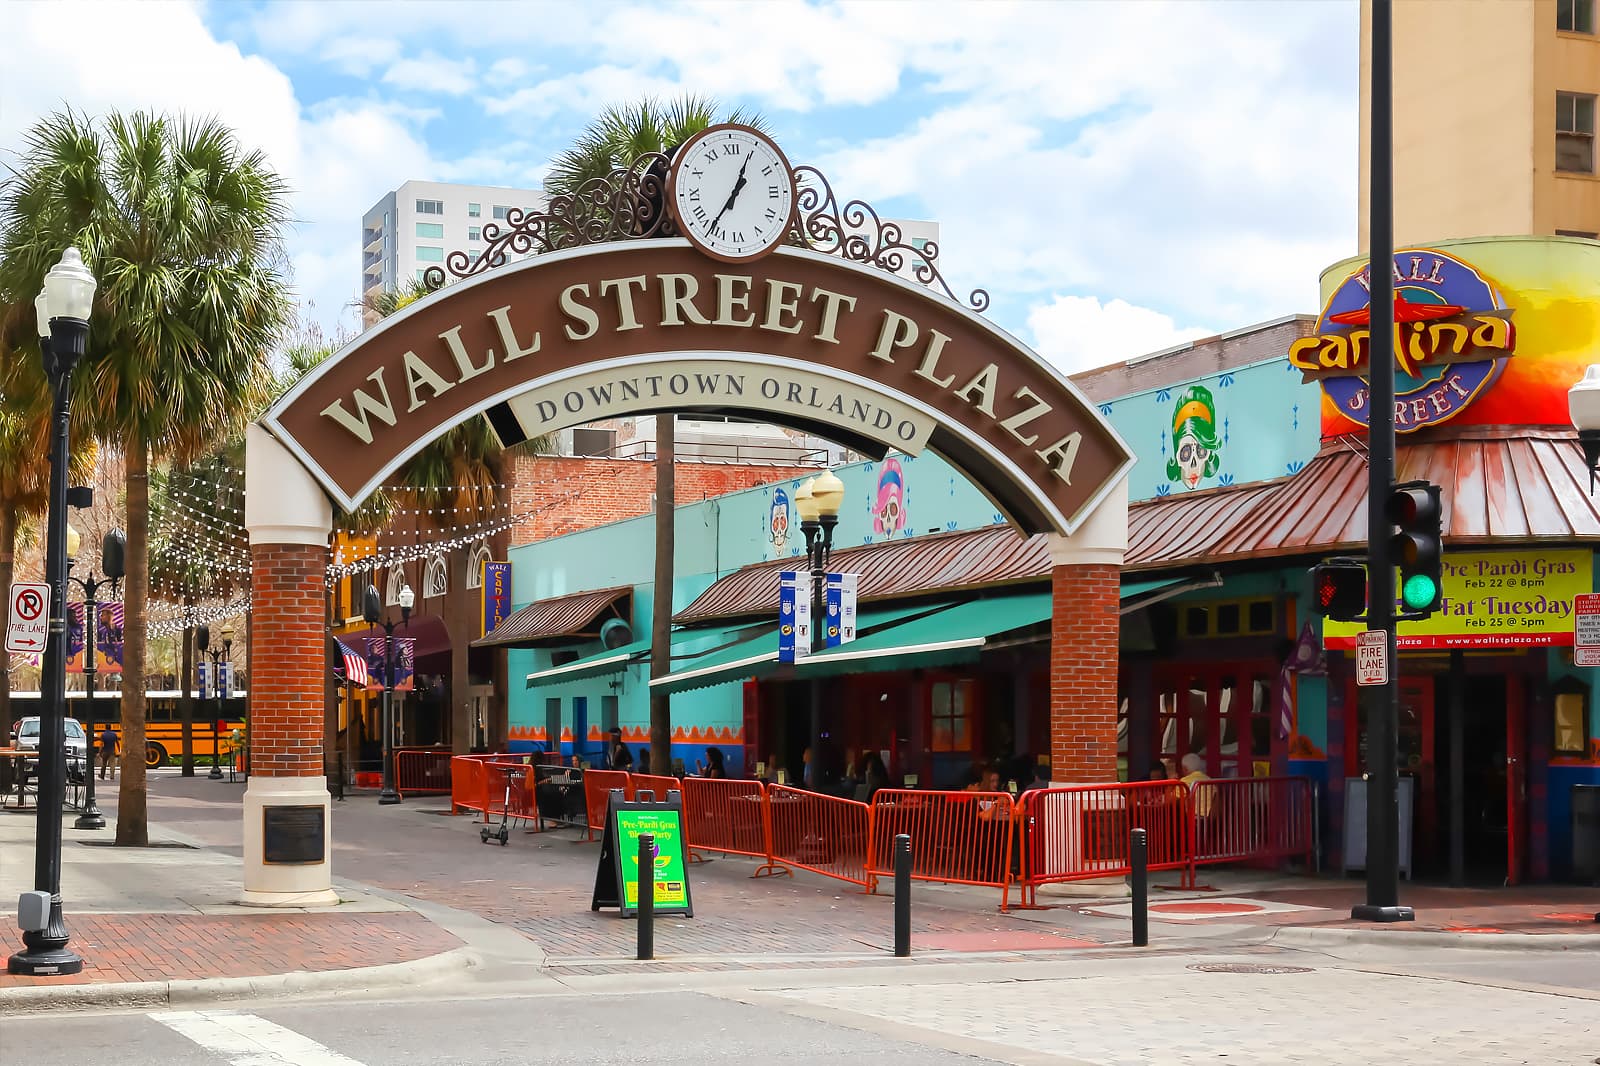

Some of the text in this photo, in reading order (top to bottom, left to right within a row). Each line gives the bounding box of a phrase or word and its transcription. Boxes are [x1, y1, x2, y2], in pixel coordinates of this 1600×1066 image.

[320, 273, 1083, 487] WALL STREET PLAZA
[1349, 375, 1471, 426] SREET
[535, 373, 916, 441] DOWNTOWN ORLANDO
[1473, 559, 1527, 577] Pardi
[1533, 559, 1576, 579] Gras
[1465, 578, 1545, 589] Feb 22 @ 8pm
[1441, 594, 1573, 619] Fat Tuesday
[1465, 617, 1545, 628] Feb 25 @ 5pm
[11, 623, 45, 634] FIRE LANE
[1446, 636, 1552, 645] www.wallstplaza.net
[1360, 647, 1382, 658] FIRE
[1360, 659, 1385, 669] LANE
